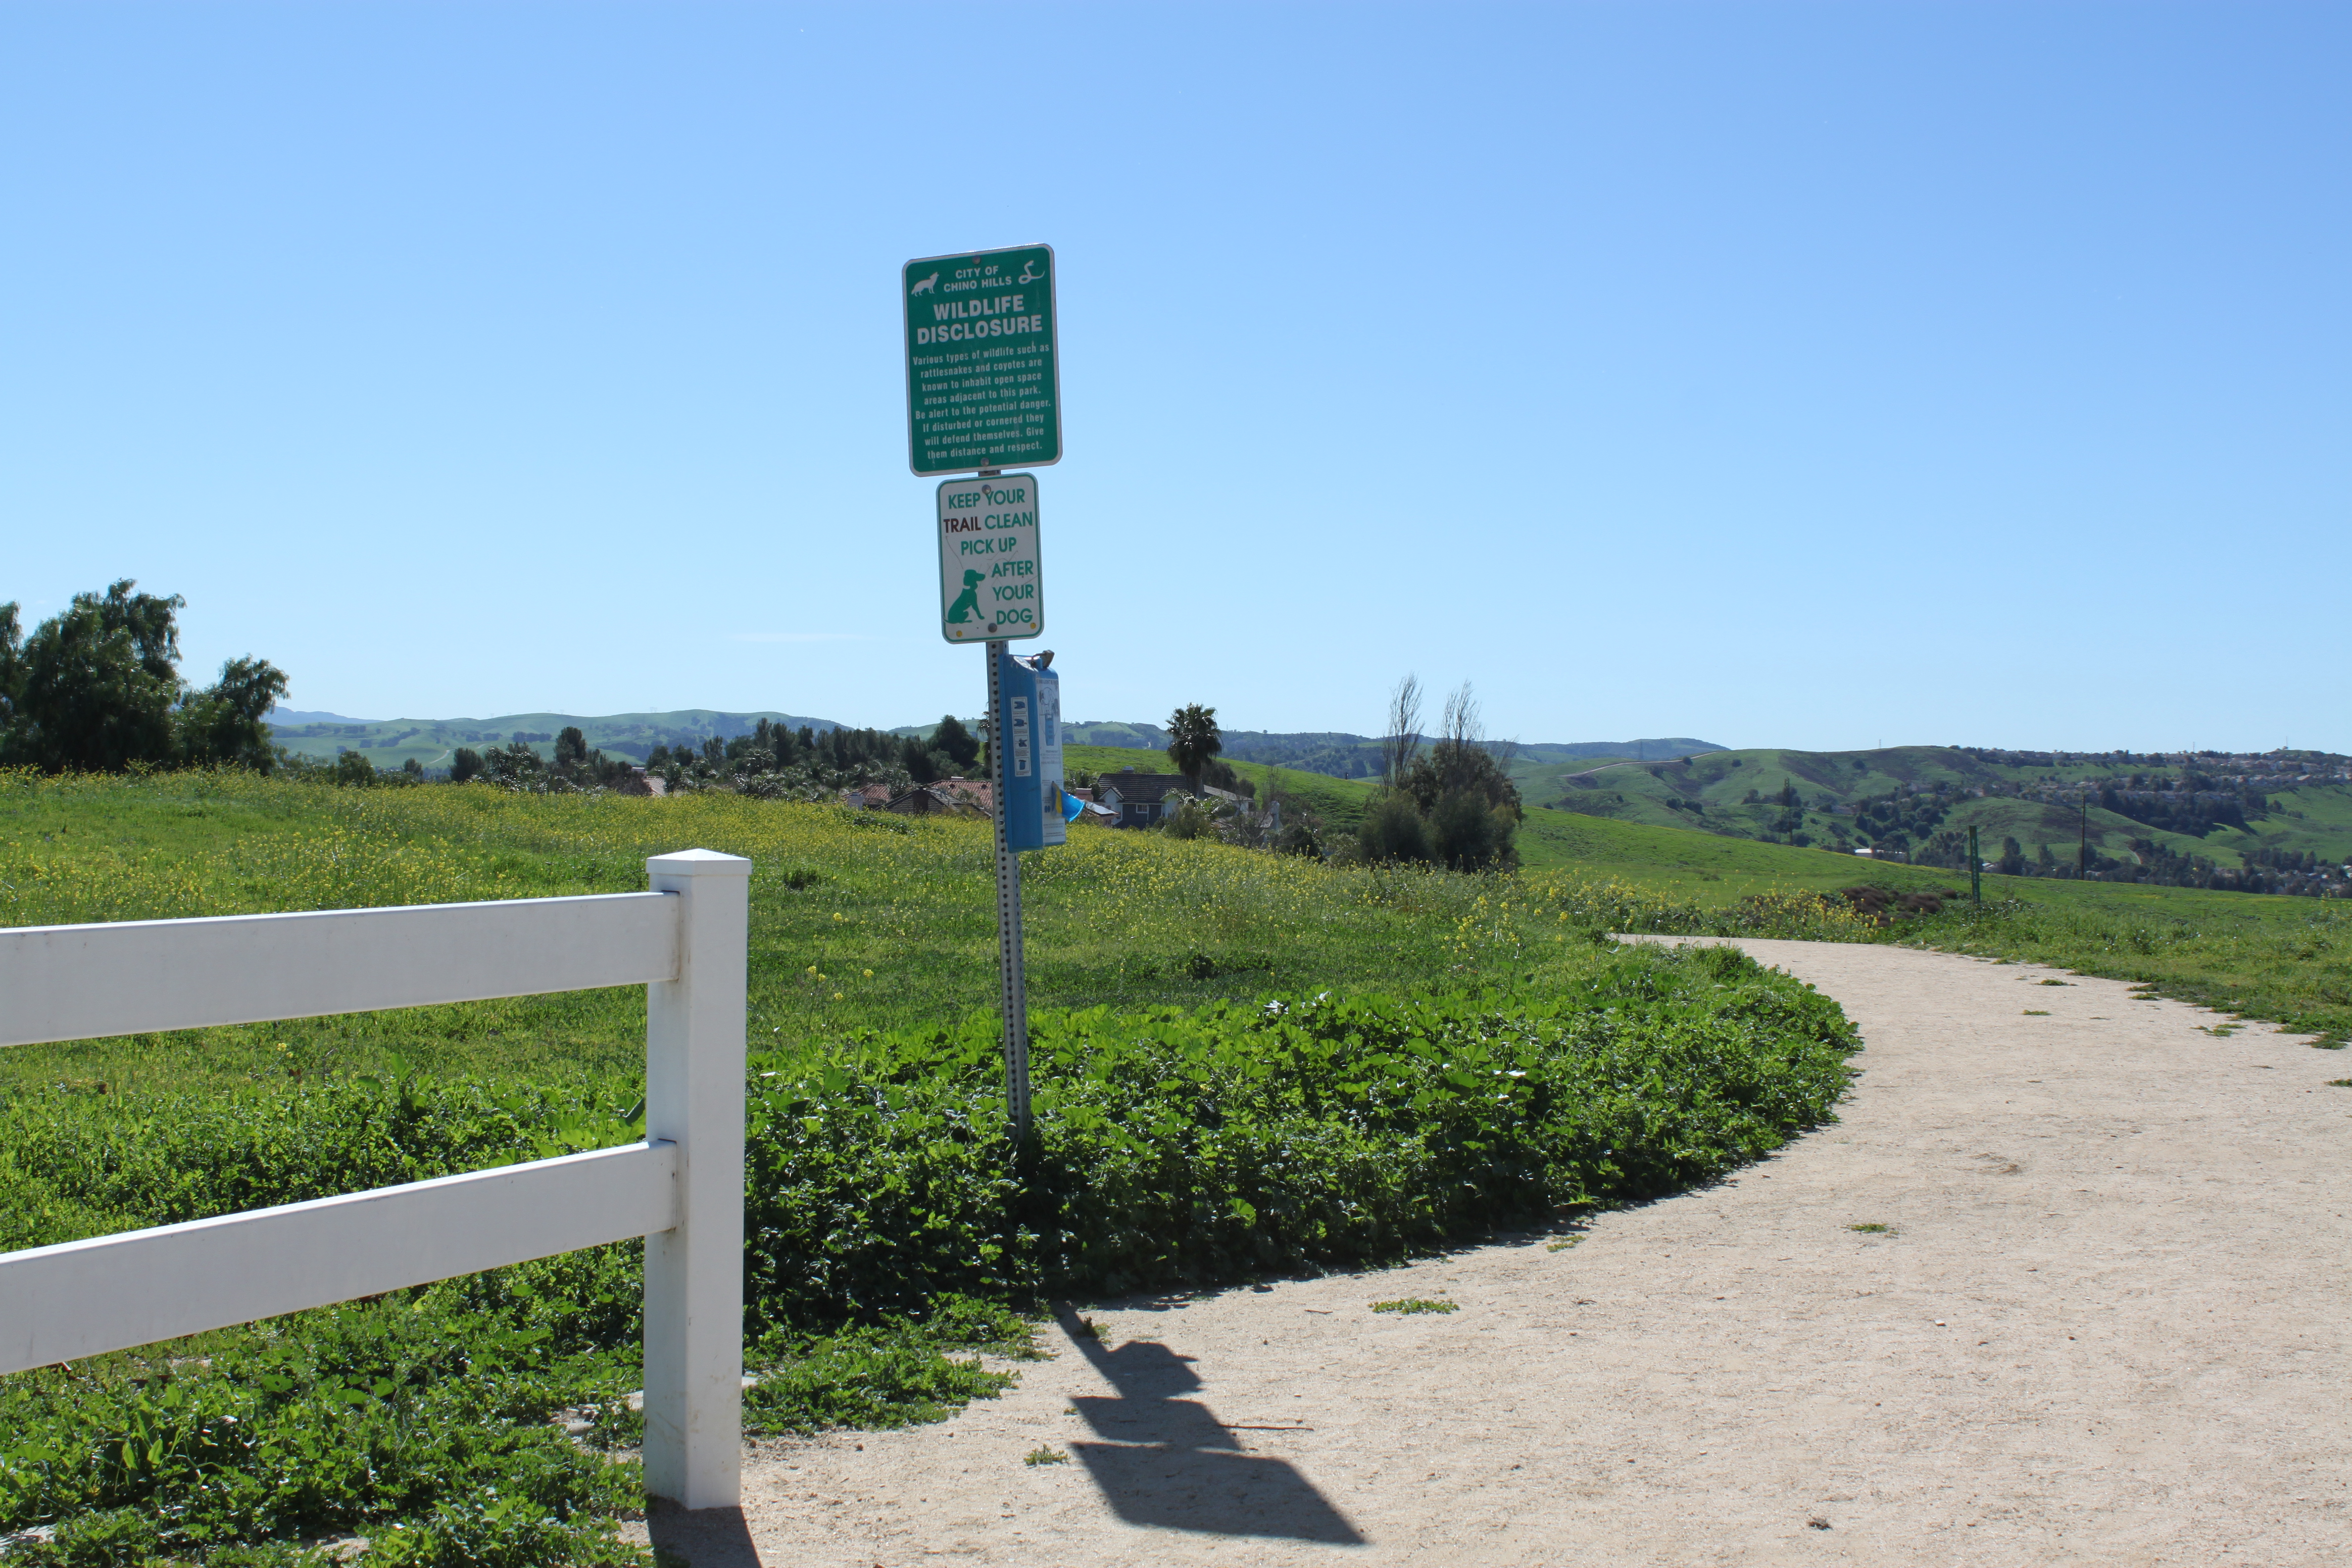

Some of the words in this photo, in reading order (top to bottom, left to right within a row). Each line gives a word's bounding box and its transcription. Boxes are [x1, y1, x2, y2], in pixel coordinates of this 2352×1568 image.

[956, 268, 980, 279] CITY
[985, 266, 998, 276] OF
[944, 280, 977, 293] CHINO
[981, 276, 1012, 288] HILLS
[933, 294, 1024, 321] WILDLIFE
[918, 315, 1042, 344] DISCLOSURE
[913, 355, 943, 365] Various
[946, 353, 969, 363] types
[972, 350, 980, 359] of
[983, 347, 1014, 357] wildlife
[1018, 343, 1036, 354] such
[921, 366, 972, 378] rattlesnakes
[976, 363, 990, 372] and
[994, 360, 1025, 371] coyotes
[922, 382, 947, 392] known
[951, 380, 959, 389] to
[962, 377, 991, 388] inhabit
[995, 375, 1014, 385] open
[1018, 372, 1041, 383] space
[924, 396, 946, 405] areas
[950, 391, 985, 403] adjacent
[989, 390, 997, 398] to
[1000, 387, 1016, 397] this
[1020, 386, 1041, 397] park.
[916, 411, 926, 419] Be
[929, 408, 948, 418] alert
[952, 407, 959, 416] to
[963, 405, 976, 415] the
[980, 401, 1017, 415] potential
[1020, 399, 1051, 411] danger.
[923, 424, 929, 433] If
[932, 418, 971, 432] disturbed
[986, 414, 1023, 426] cornered
[1026, 414, 1044, 423] they
[925, 436, 939, 445] will
[942, 433, 970, 444] defend
[974, 430, 1023, 441] themselves.
[1027, 428, 1044, 437] Give
[928, 449, 947, 459] them
[951, 445, 986, 457] distance
[989, 443, 1004, 453] and
[1008, 441, 1042, 453] respect.
[948, 492, 980, 509] KEEP
[986, 489, 1025, 506] YOUR
[943, 516, 981, 533] TRAIL
[985, 512, 1032, 530] CLEAN
[961, 539, 994, 555] PICK
[999, 537, 1017, 552] UP
[991, 560, 1033, 578] AFTER
[992, 584, 1034, 601] YOUR
[996, 608, 1033, 625] DOG
